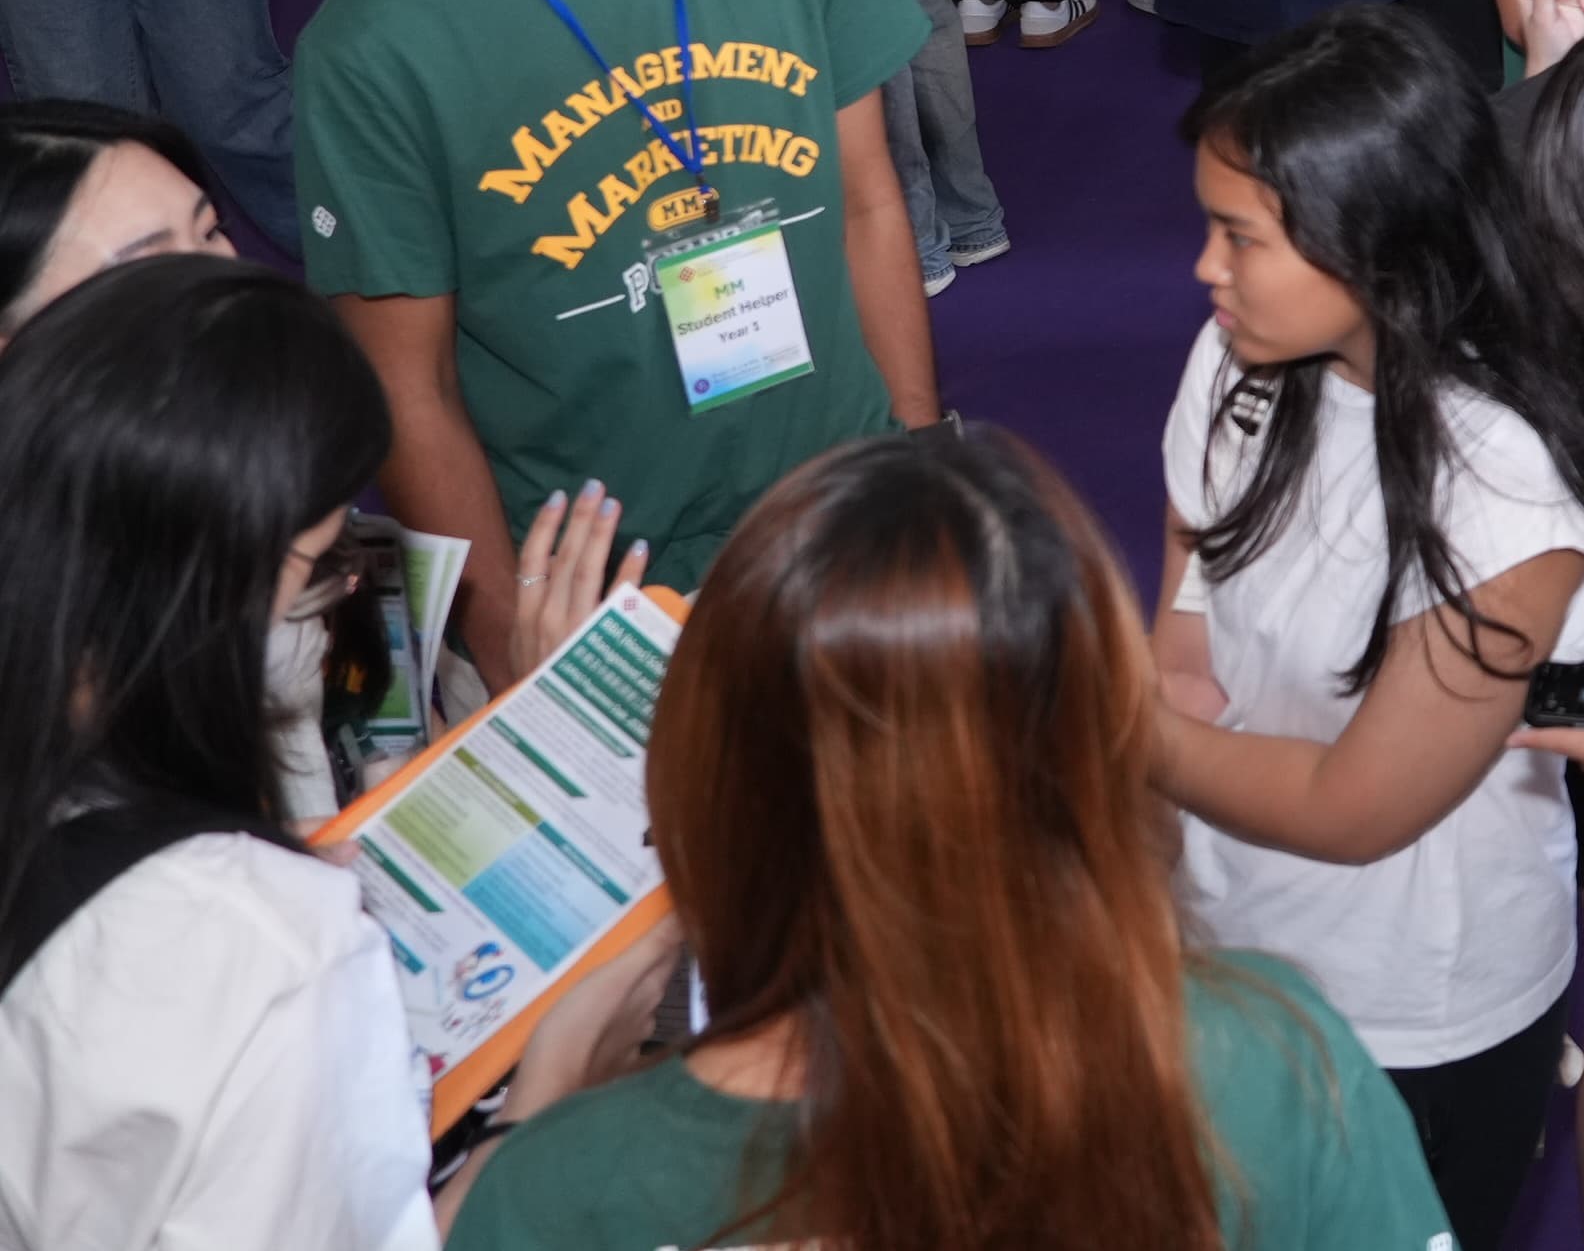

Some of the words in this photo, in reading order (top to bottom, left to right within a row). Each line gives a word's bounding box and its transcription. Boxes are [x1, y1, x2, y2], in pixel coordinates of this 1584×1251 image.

[478, 42, 818, 204] MANAGEMENT
[531, 124, 819, 270] MARKETING
[677, 306, 737, 335] Student
[740, 289, 788, 315] Helper
[715, 279, 745, 299] MM
[719, 327, 749, 343] Year
